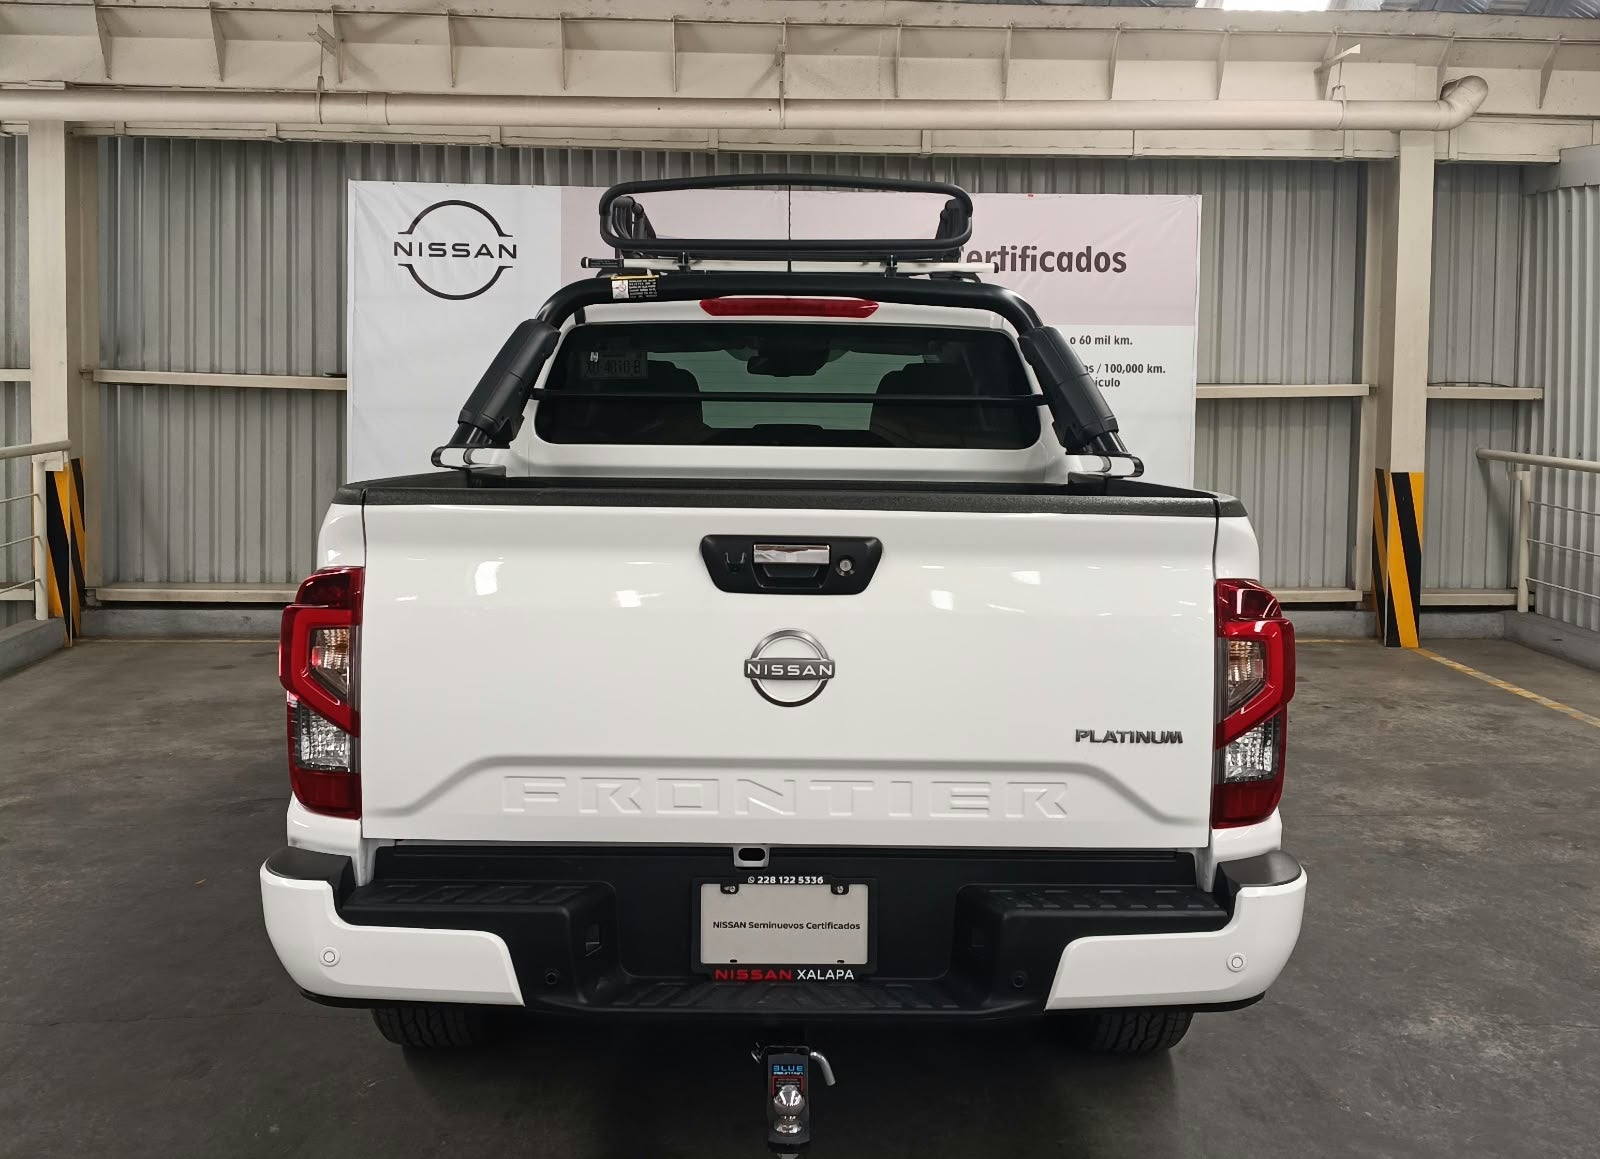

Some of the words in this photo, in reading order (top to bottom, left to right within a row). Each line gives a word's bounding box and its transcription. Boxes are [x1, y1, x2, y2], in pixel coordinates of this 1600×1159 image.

[393, 241, 517, 259] NISSAN
[961, 245, 1127, 273] ertificados
[1069, 336, 1076, 345] o
[1079, 335, 1091, 345] 60
[1094, 335, 1111, 345] mil
[1114, 335, 1133, 345] km.
[1104, 363, 1144, 375] 100,000
[1147, 363, 1166, 374] km.
[1094, 376, 1121, 388] ículo
[747, 663, 833, 676] NISSAN
[1075, 728, 1184, 744] PLATINUM
[503, 775, 1068, 819] FRONTIER
[757, 876, 777, 884] 228
[778, 876, 797, 884] 122
[798, 876, 824, 885] 5336
[712, 921, 747, 930] NISSAN
[748, 921, 805, 931] Seminuevos
[806, 921, 861, 931] Certificados
[714, 968, 793, 981] NISSAN
[797, 968, 855, 981] XALAPA
